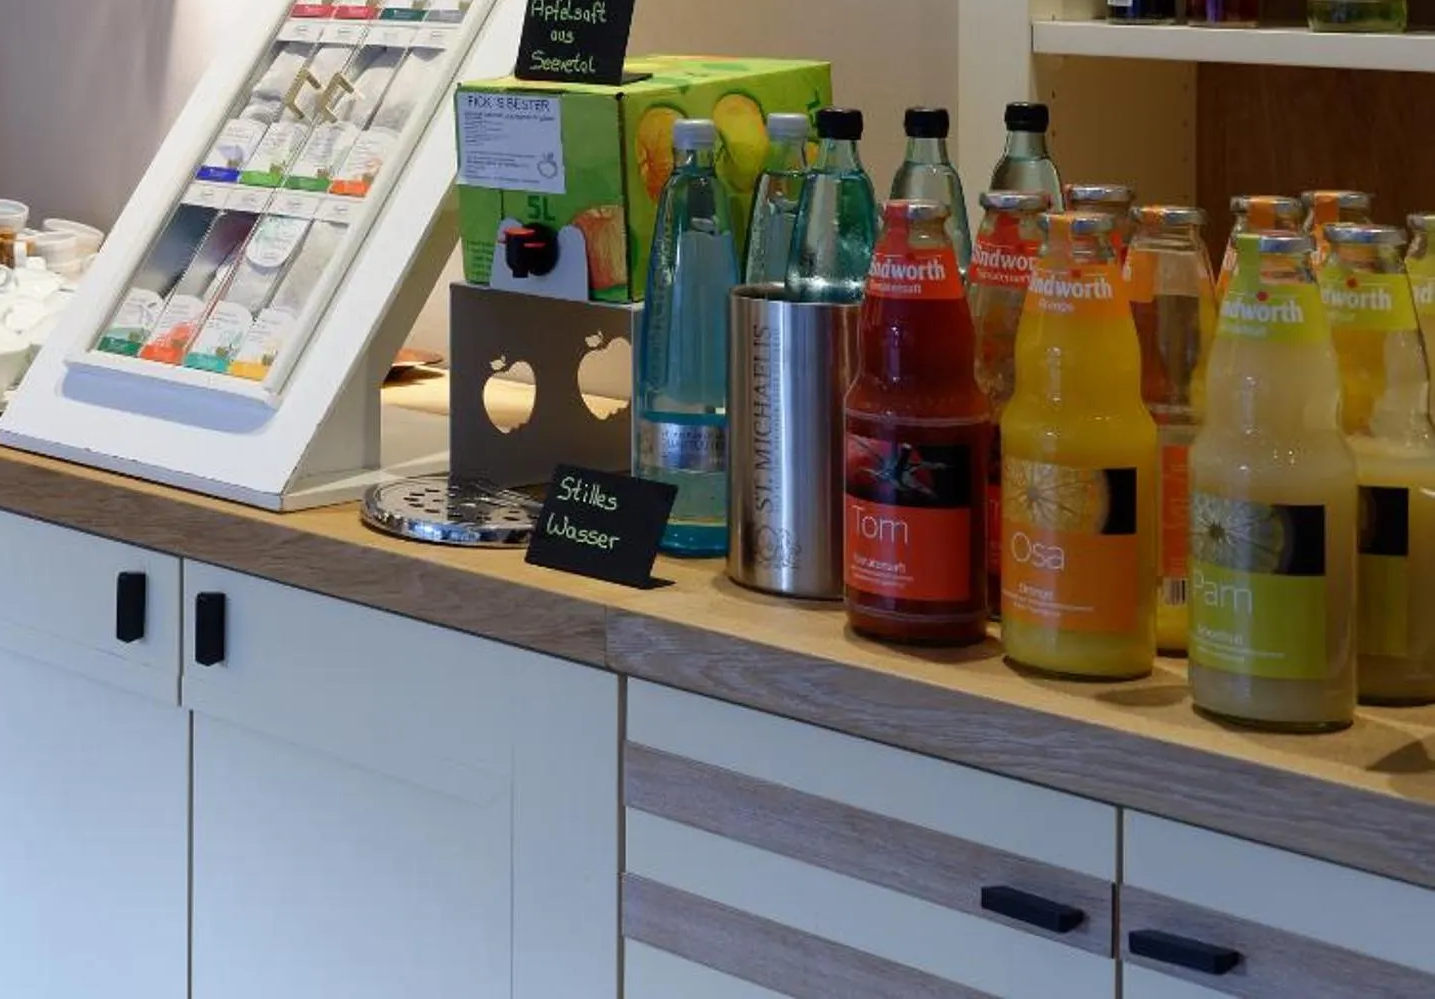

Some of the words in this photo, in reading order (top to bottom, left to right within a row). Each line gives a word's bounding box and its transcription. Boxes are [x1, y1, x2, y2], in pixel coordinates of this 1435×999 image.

[550, 30, 574, 43] aus
[527, 195, 556, 221] 5L
[556, 475, 619, 511] Stilles
[545, 511, 621, 550] Wasser
[851, 504, 909, 545] Tom
[1011, 531, 1065, 573] Osa
[1192, 568, 1253, 615] Pam
